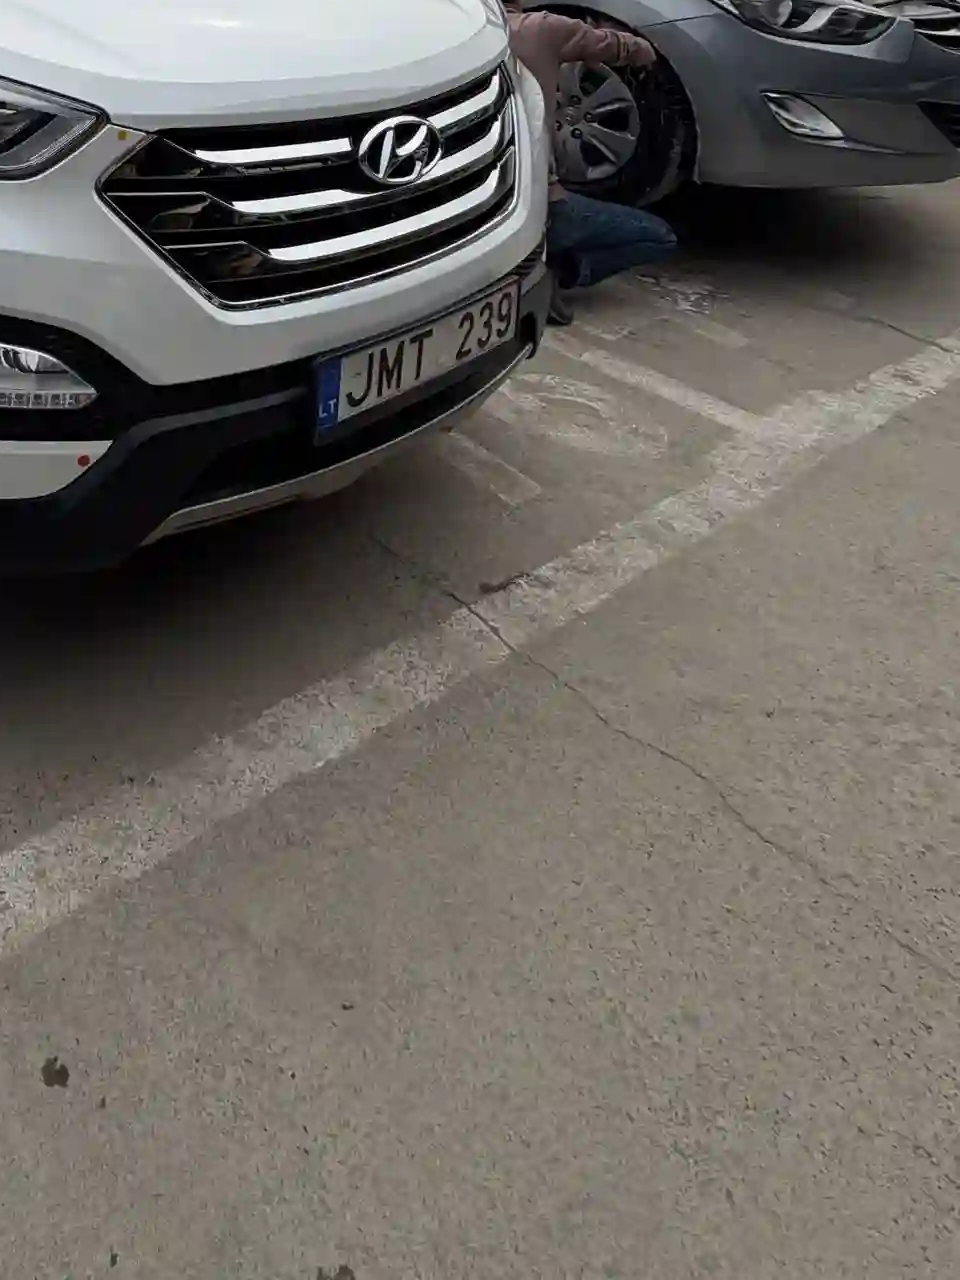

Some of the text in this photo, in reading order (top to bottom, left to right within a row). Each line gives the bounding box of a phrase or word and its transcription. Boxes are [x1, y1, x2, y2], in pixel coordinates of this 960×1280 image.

[345, 291, 513, 407] JMT 239
[318, 397, 338, 419] LT
